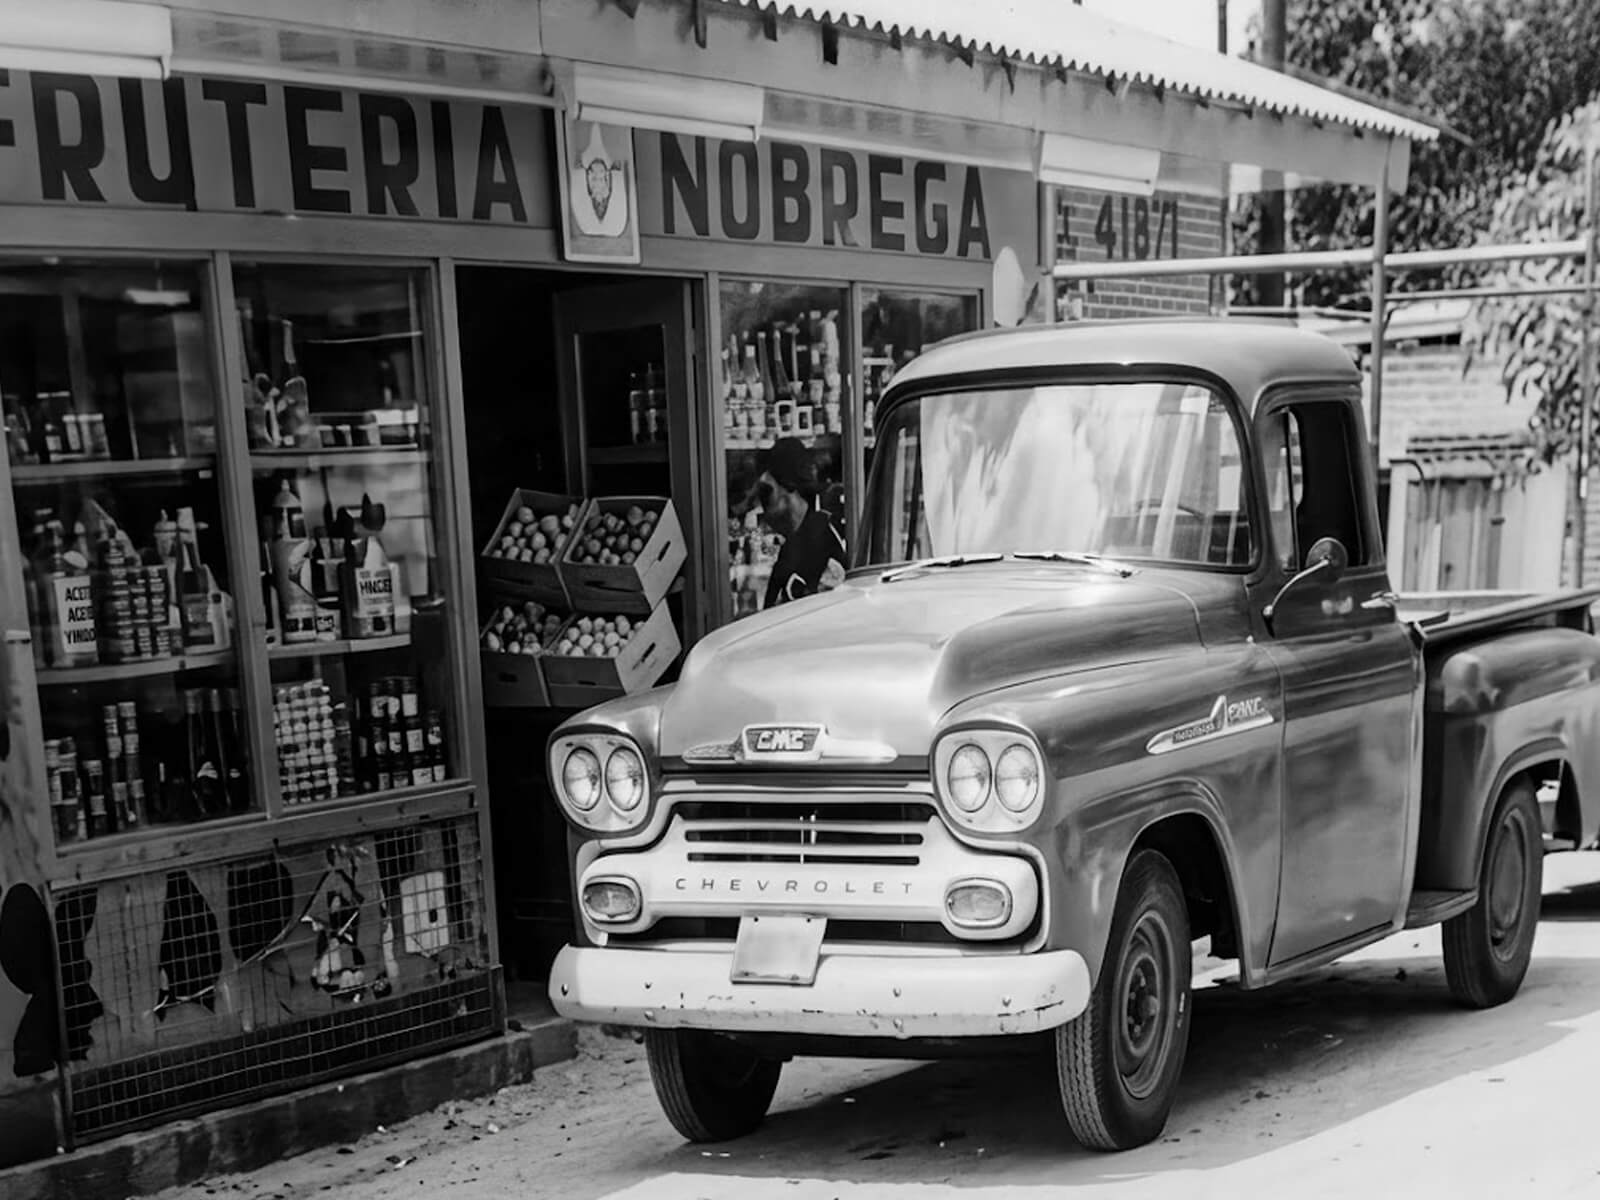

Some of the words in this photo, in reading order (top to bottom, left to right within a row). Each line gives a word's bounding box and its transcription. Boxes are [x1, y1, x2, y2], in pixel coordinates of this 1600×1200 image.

[0, 68, 528, 223] RUTERIA
[660, 131, 991, 259] NOBREGA
[675, 878, 913, 895] CHEVROLET
